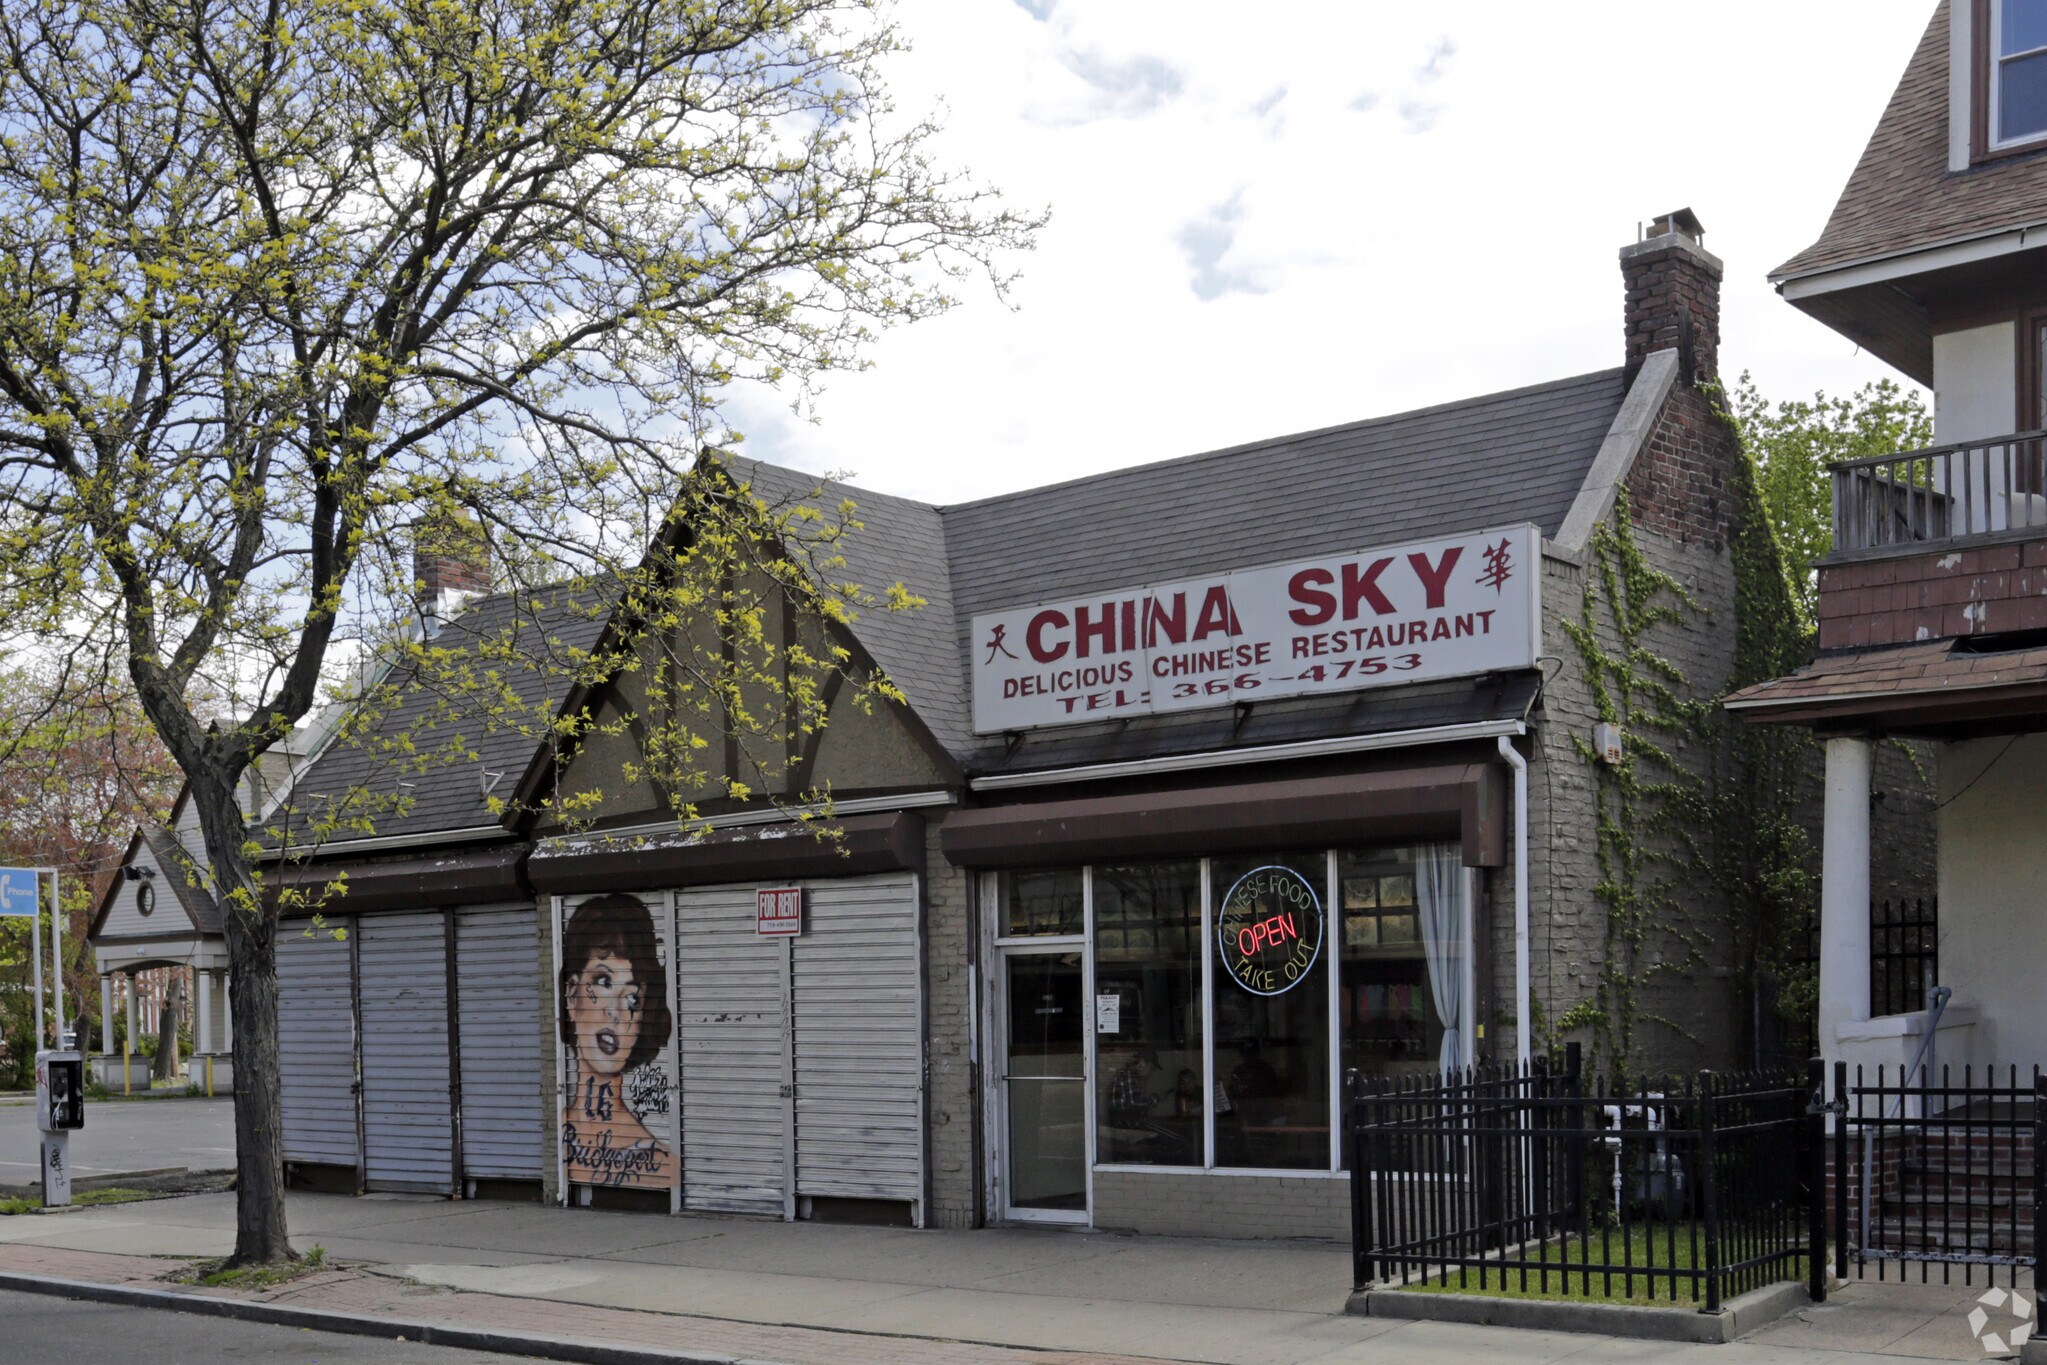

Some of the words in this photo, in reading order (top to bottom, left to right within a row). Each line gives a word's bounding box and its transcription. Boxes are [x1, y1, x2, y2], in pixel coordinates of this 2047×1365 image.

[1026, 584, 1243, 664] CHINA
[1288, 546, 1464, 626] SKY
[1003, 661, 1133, 699] DELICIOUS
[1152, 642, 1271, 677] CHINESE
[1292, 609, 1496, 659] RESTAURANT
[1172, 653, 1422, 699] 366-4753
[7, 887, 33, 897] Phone
[760, 893, 776, 917] FOR
[778, 892, 798, 917] RENT
[1223, 875, 1268, 946] CHINESE
[1270, 875, 1311, 910] FOOD
[1238, 912, 1297, 956] OPEN
[1234, 956, 1276, 990] TAKE
[1284, 937, 1314, 980] OUT
